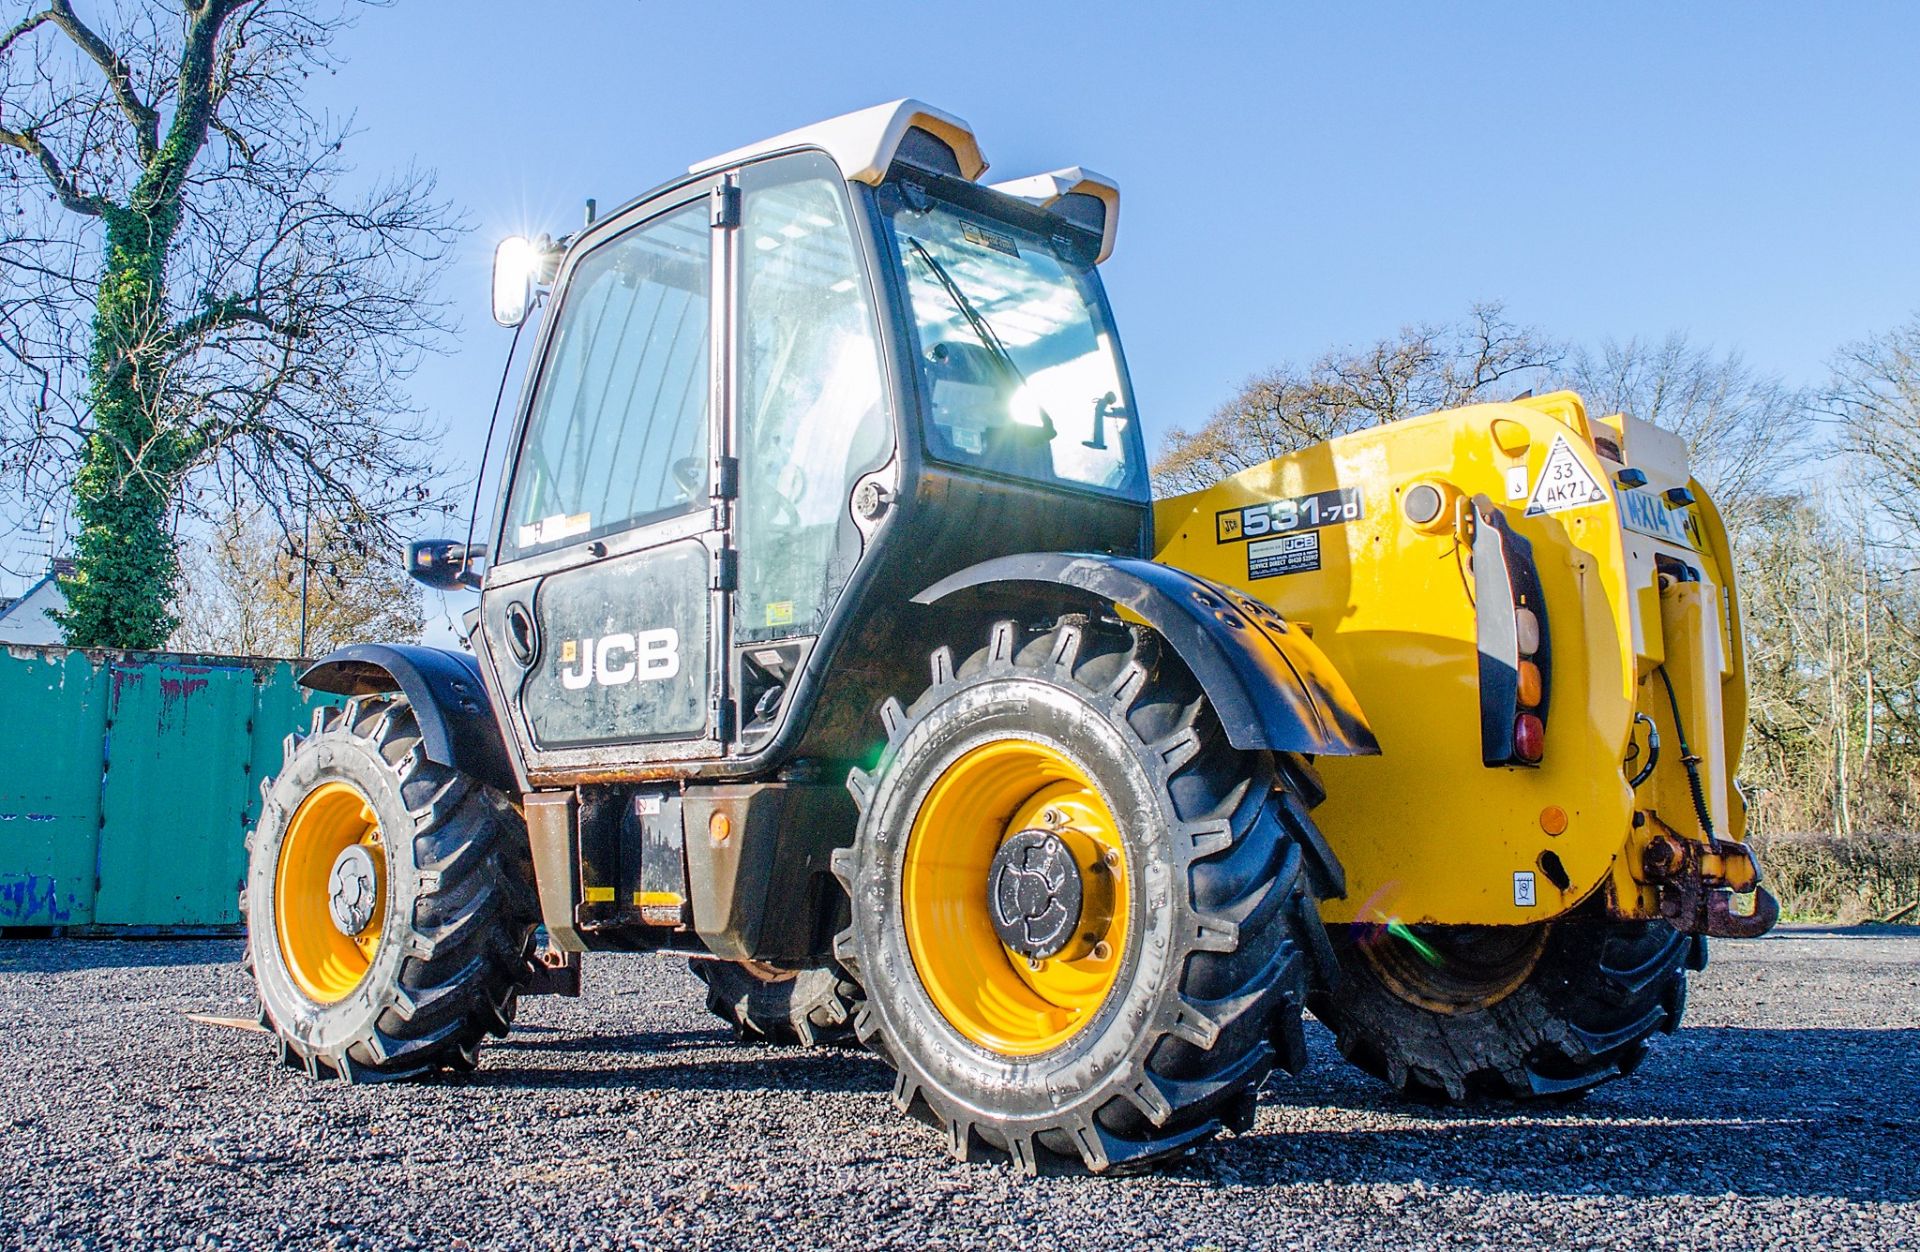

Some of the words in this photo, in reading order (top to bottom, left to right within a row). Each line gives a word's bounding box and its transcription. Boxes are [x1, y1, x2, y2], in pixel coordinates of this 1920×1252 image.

[1553, 463, 1573, 480] 33
[1626, 490, 1670, 534] MX14
[1286, 537, 1315, 550] JCB
[562, 627, 680, 690] JCB
